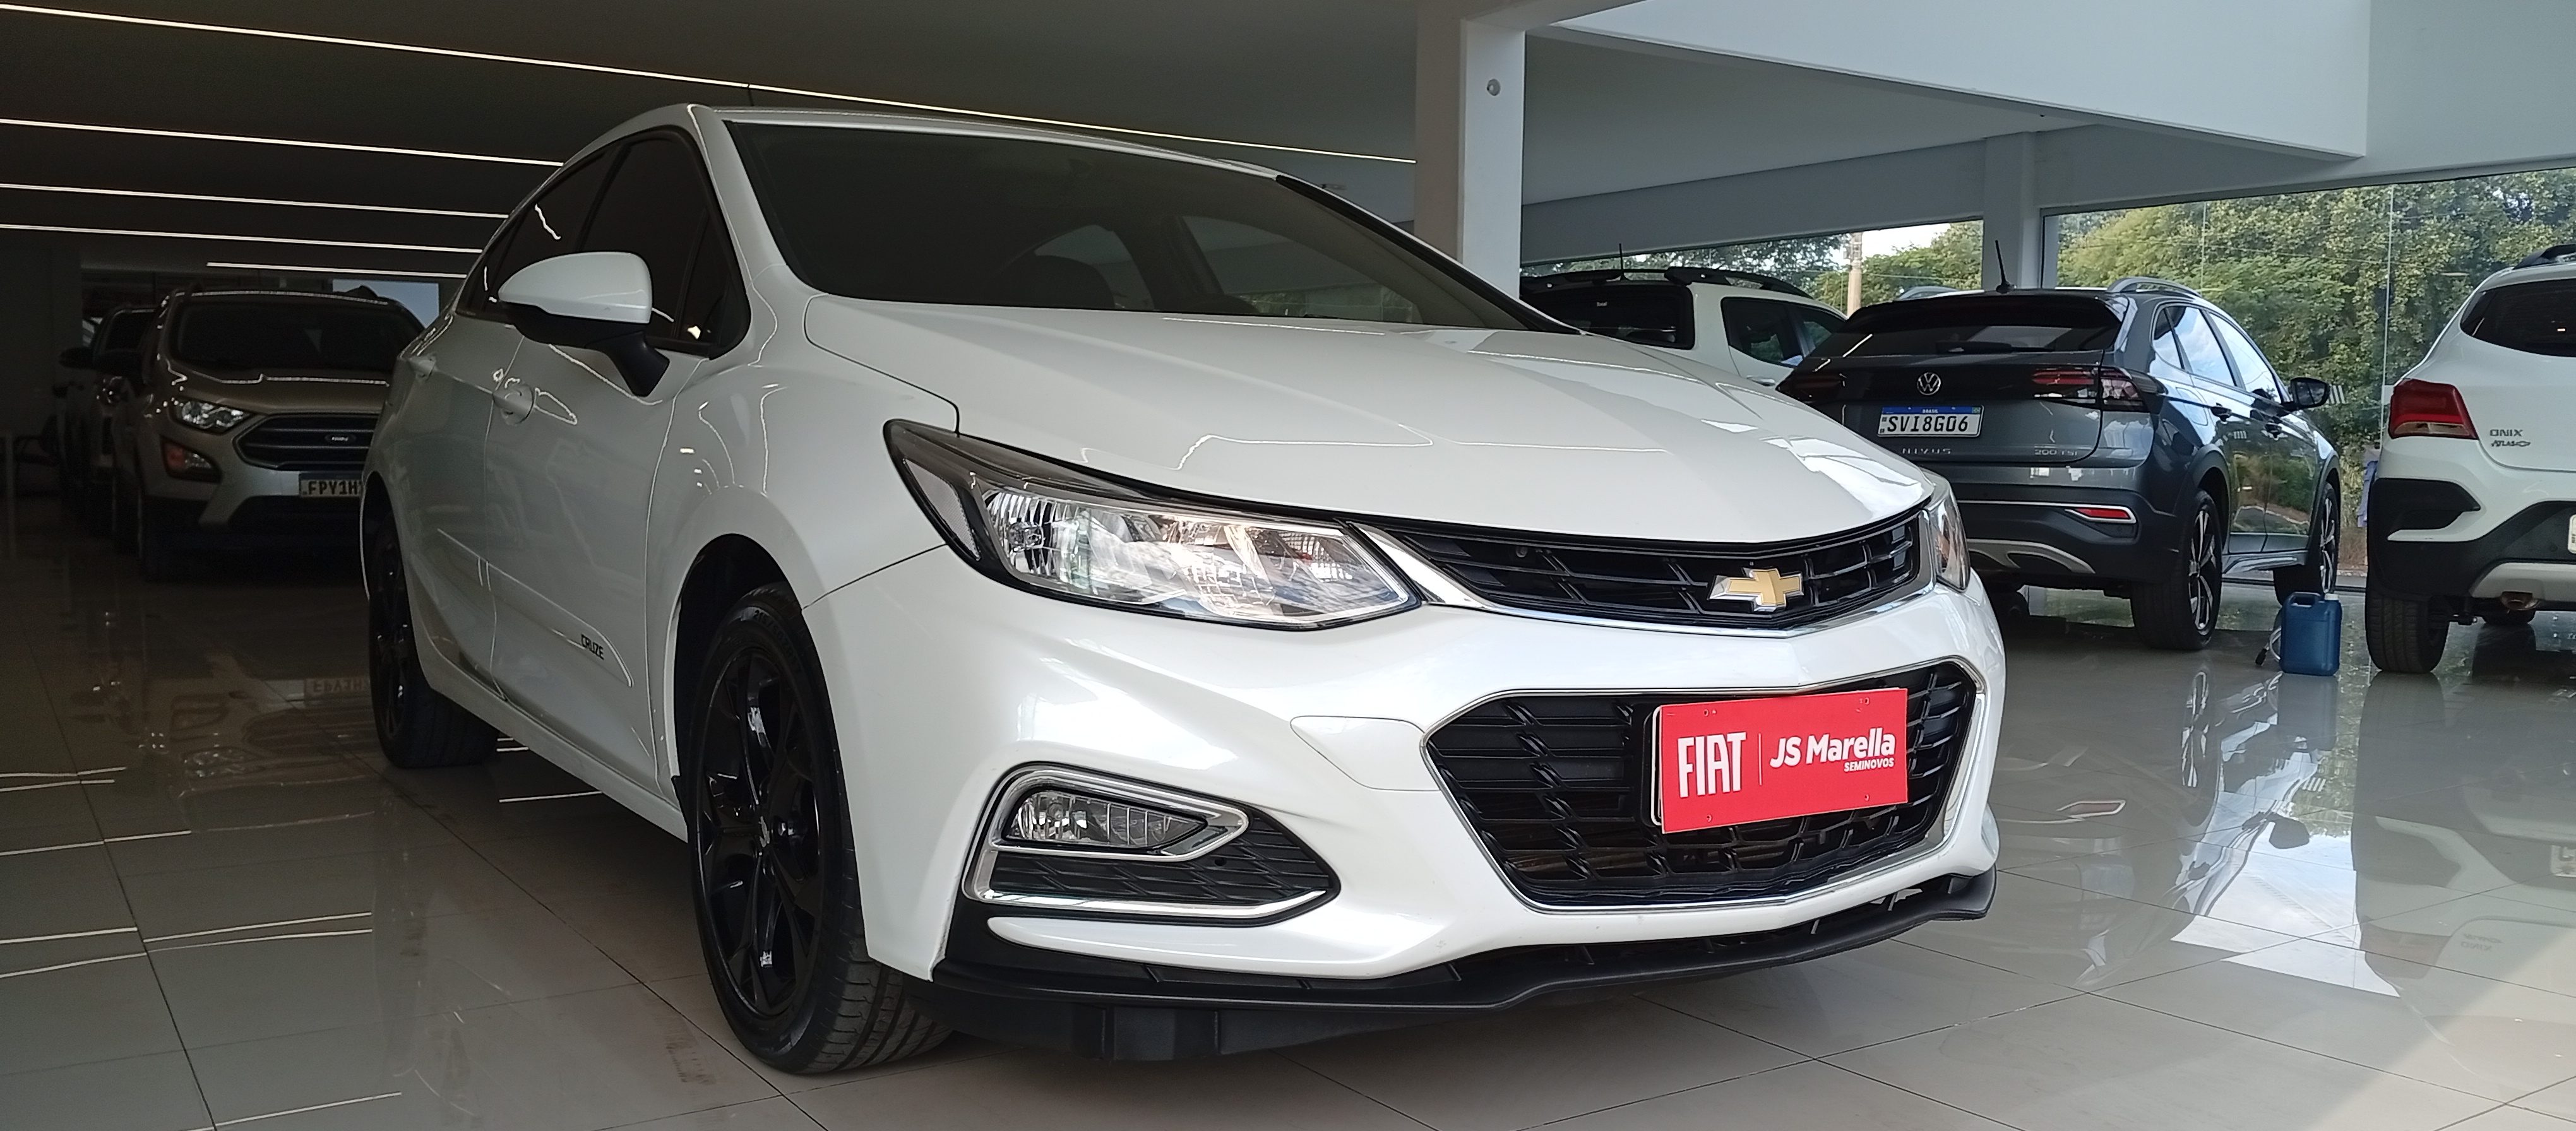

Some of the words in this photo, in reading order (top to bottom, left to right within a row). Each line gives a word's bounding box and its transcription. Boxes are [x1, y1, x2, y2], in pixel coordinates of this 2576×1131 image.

[1887, 415, 1969, 432] SVI8G06
[2490, 429, 2524, 437] ONIX
[581, 633, 605, 661] CRUZE
[1770, 736, 1802, 768] JS
[1806, 727, 1896, 764] Marella
[1678, 731, 1746, 798] FIAT
[1844, 757, 1895, 773] SEMINOVOS
